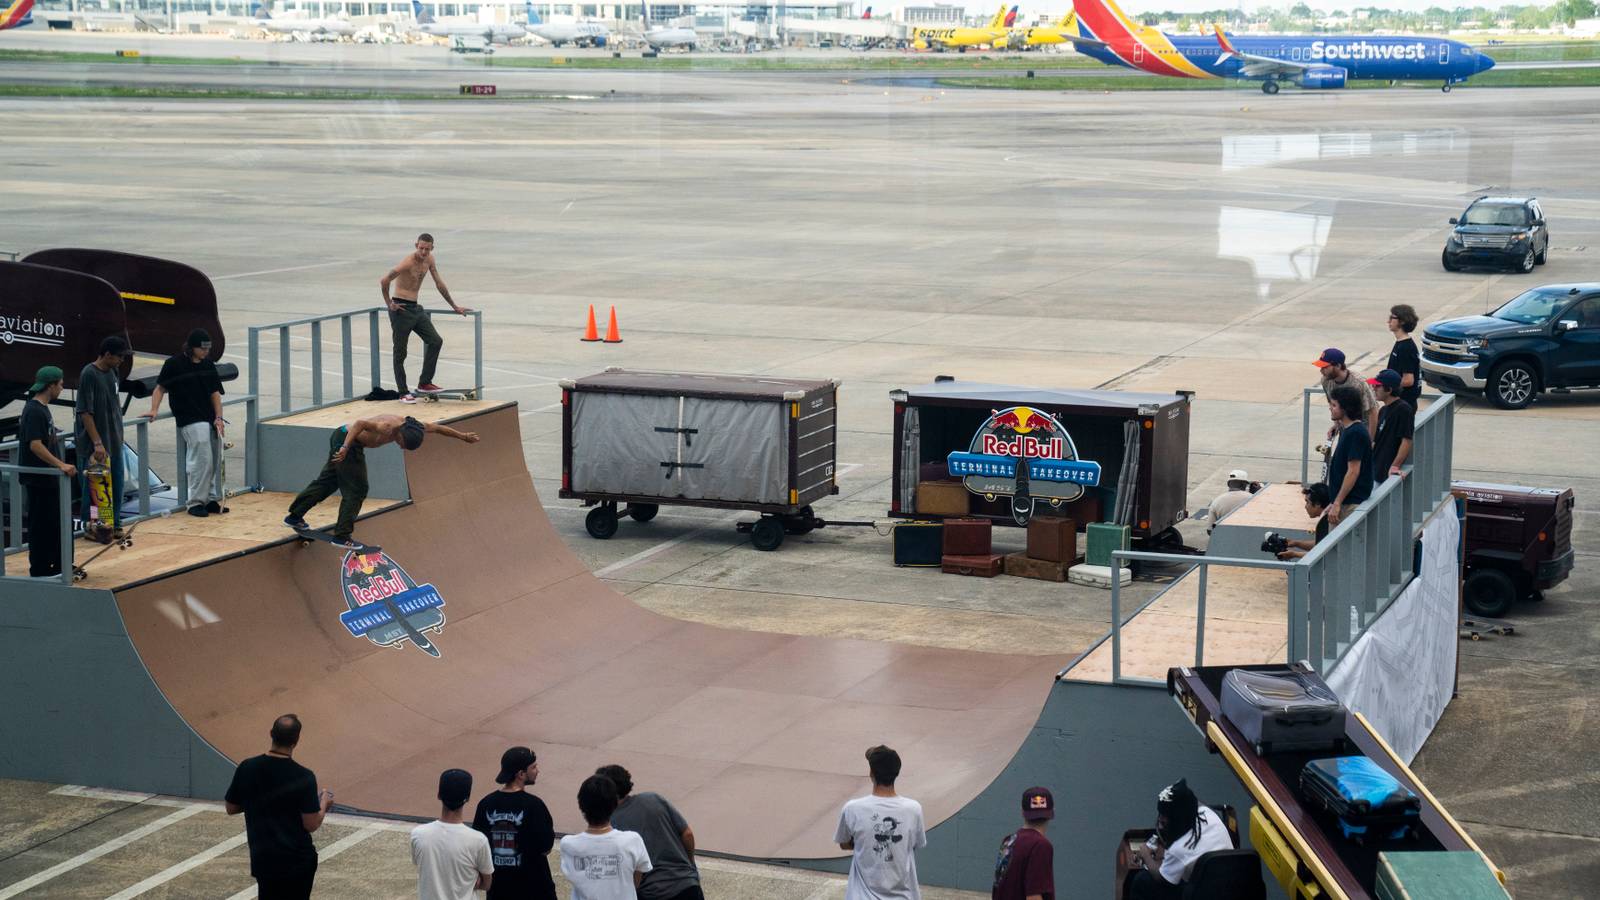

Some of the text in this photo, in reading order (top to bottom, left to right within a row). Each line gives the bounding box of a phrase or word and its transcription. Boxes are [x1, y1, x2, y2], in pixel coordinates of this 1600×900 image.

[919, 28, 955, 39] spirit
[1311, 41, 1426, 59] Southwest
[0, 315, 65, 337] aviation
[983, 433, 1063, 460] Red Bull
[953, 461, 1095, 481] TERMINAL TAKEOVER
[348, 569, 408, 605] Red Bull
[348, 592, 439, 632] TERMINAL TAKEOVER
